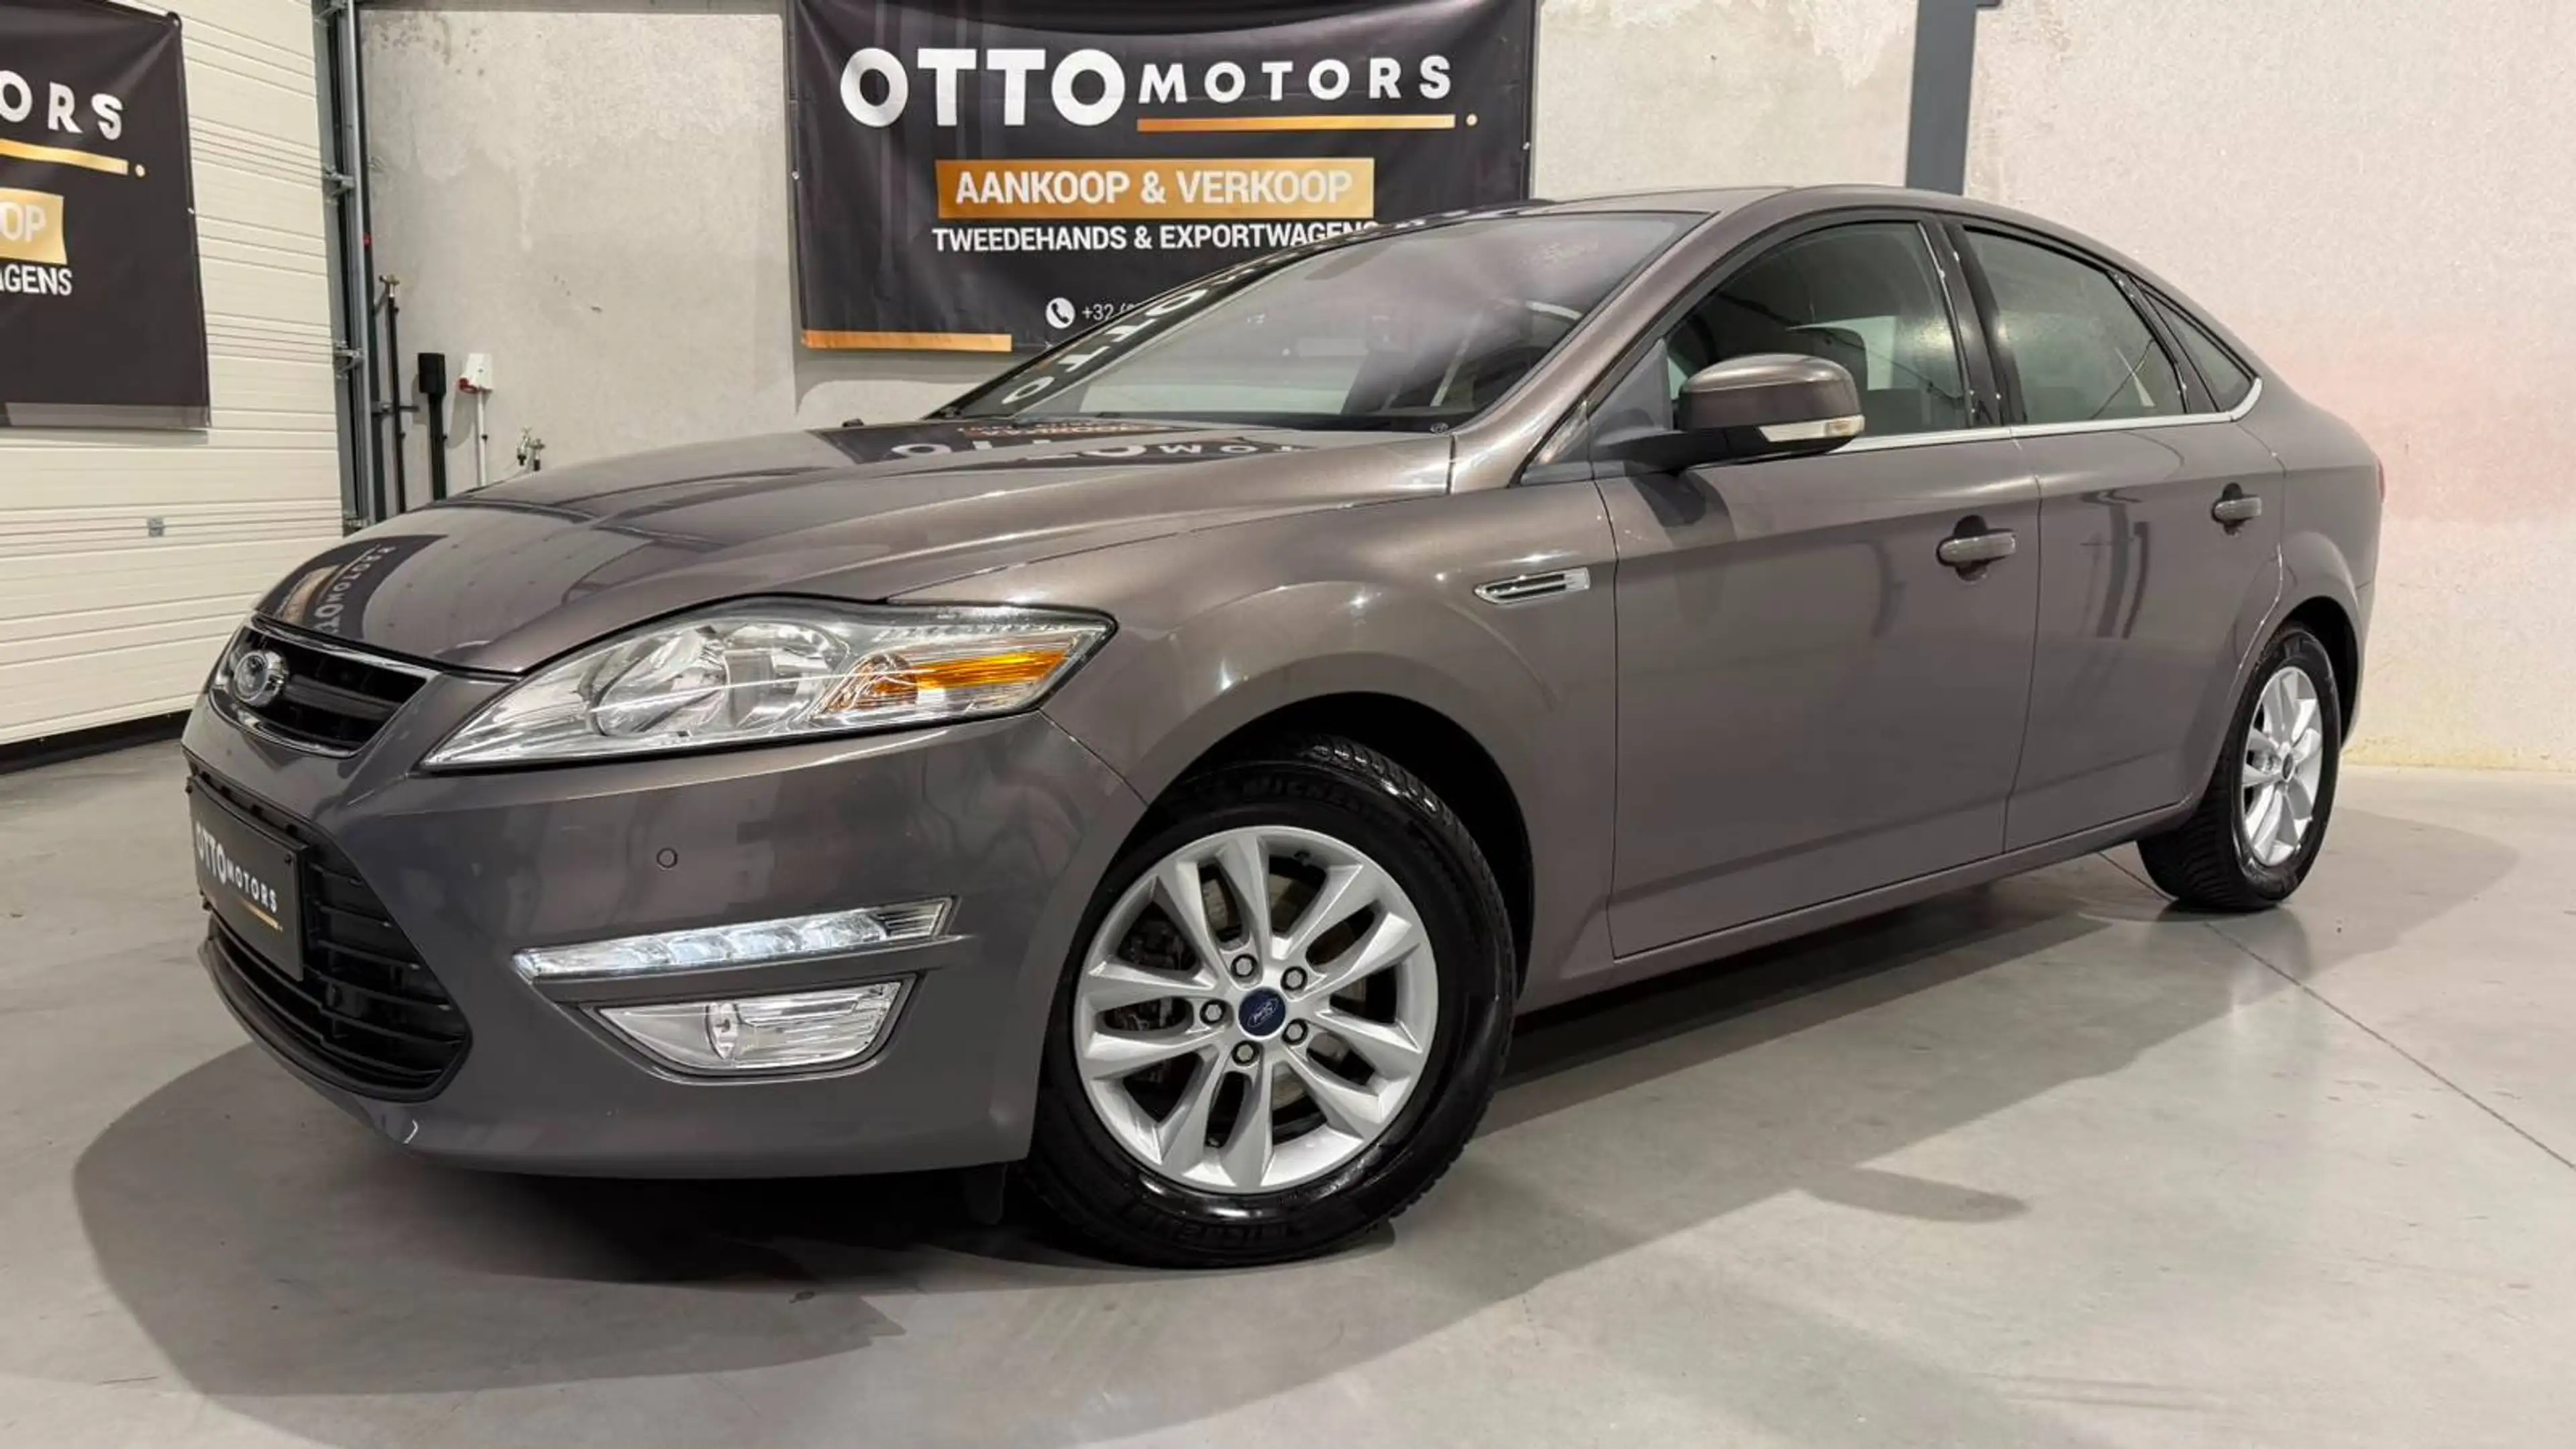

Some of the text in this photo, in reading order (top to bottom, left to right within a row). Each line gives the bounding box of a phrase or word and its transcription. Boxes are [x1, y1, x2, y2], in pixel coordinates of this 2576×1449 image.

[840, 48, 1452, 127] OTTO MOTORS
[955, 170, 1352, 204] AANKOOP & VERKOOP
[0, 201, 47, 242] OP
[932, 221, 1379, 253] TWEEDEHANDS & EXPORTWAGE
[196, 821, 278, 913] OTTO MOTORS
